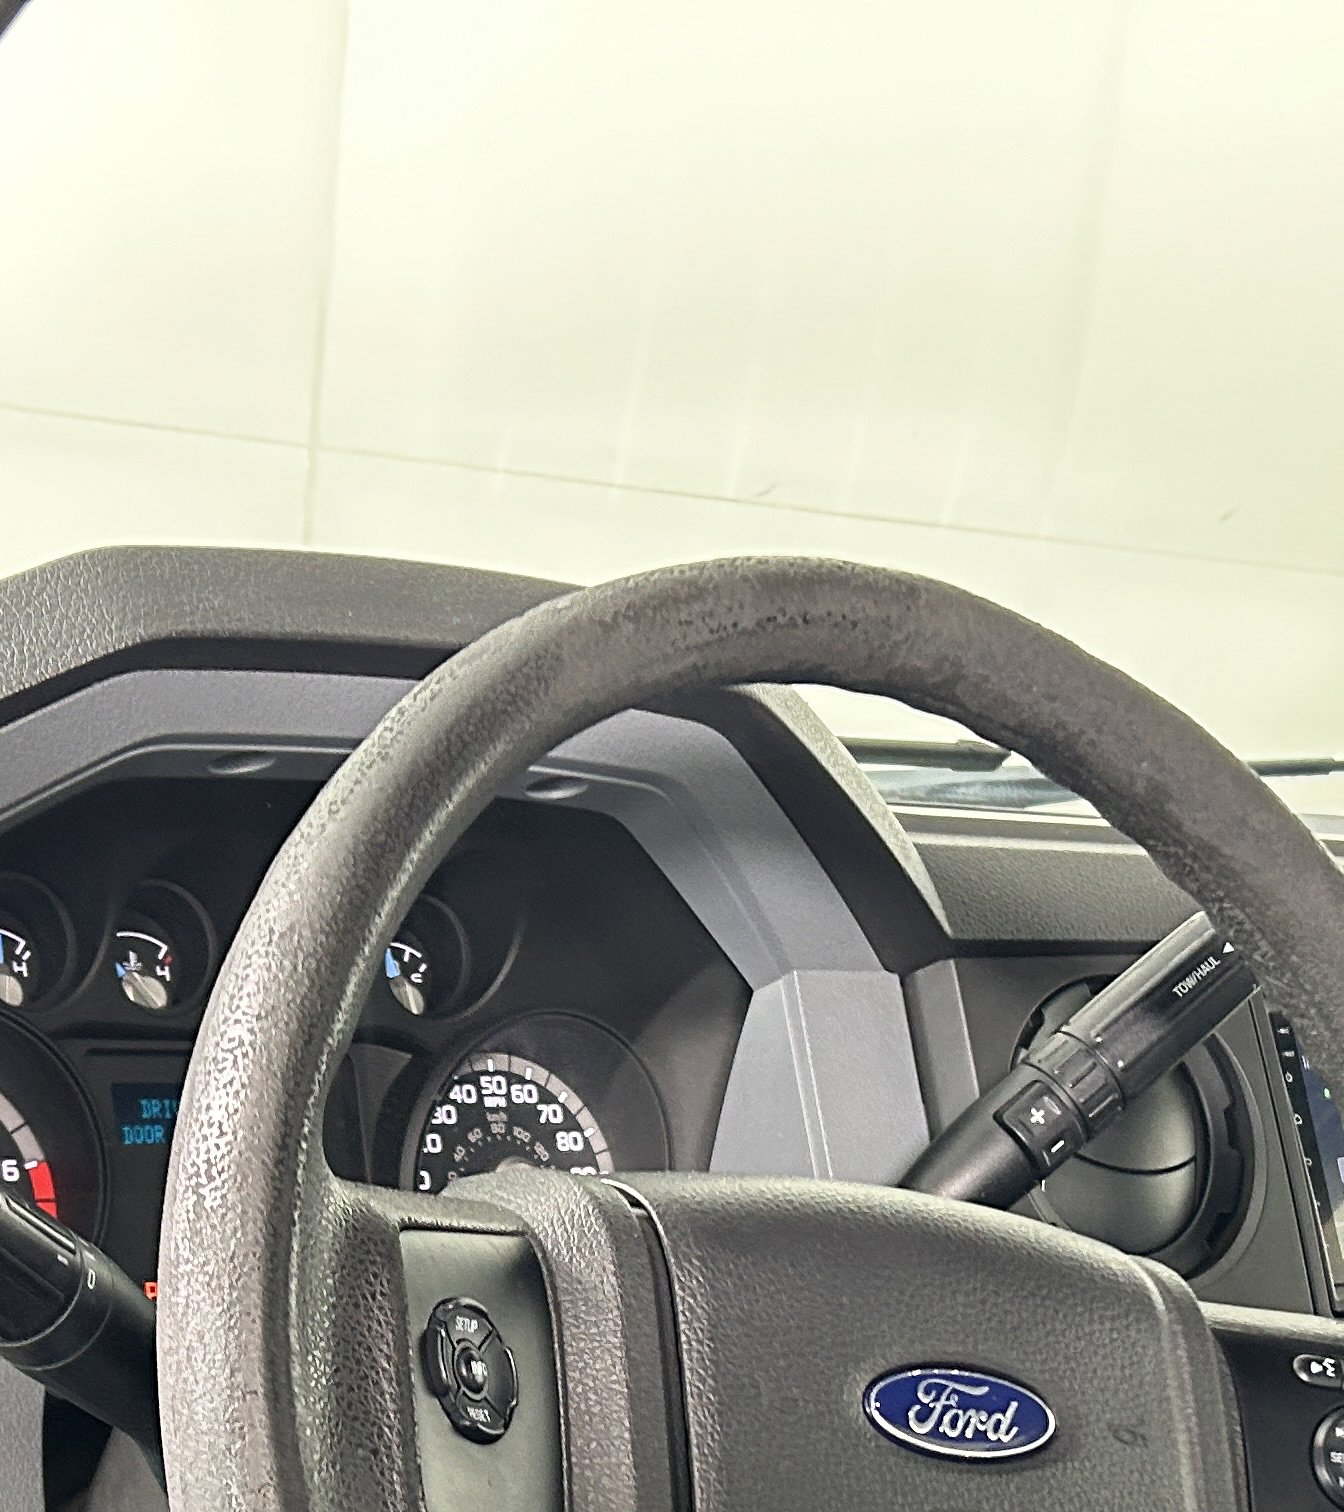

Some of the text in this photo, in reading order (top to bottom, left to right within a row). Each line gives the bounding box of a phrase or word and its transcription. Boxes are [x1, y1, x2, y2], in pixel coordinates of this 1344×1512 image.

[1171, 956, 1221, 998] TOW/HAUL
[449, 1084, 477, 1104] 40
[480, 1075, 507, 1095] 50
[510, 1084, 539, 1104] 60
[484, 1096, 507, 1108] MPH
[536, 1103, 563, 1124] 70
[122, 1125, 165, 1145] DOOR
[555, 1131, 584, 1151] 80
[1, 1159, 19, 1182] 6
[456, 1316, 478, 1333] SETUP
[908, 1378, 1019, 1444] Ford
